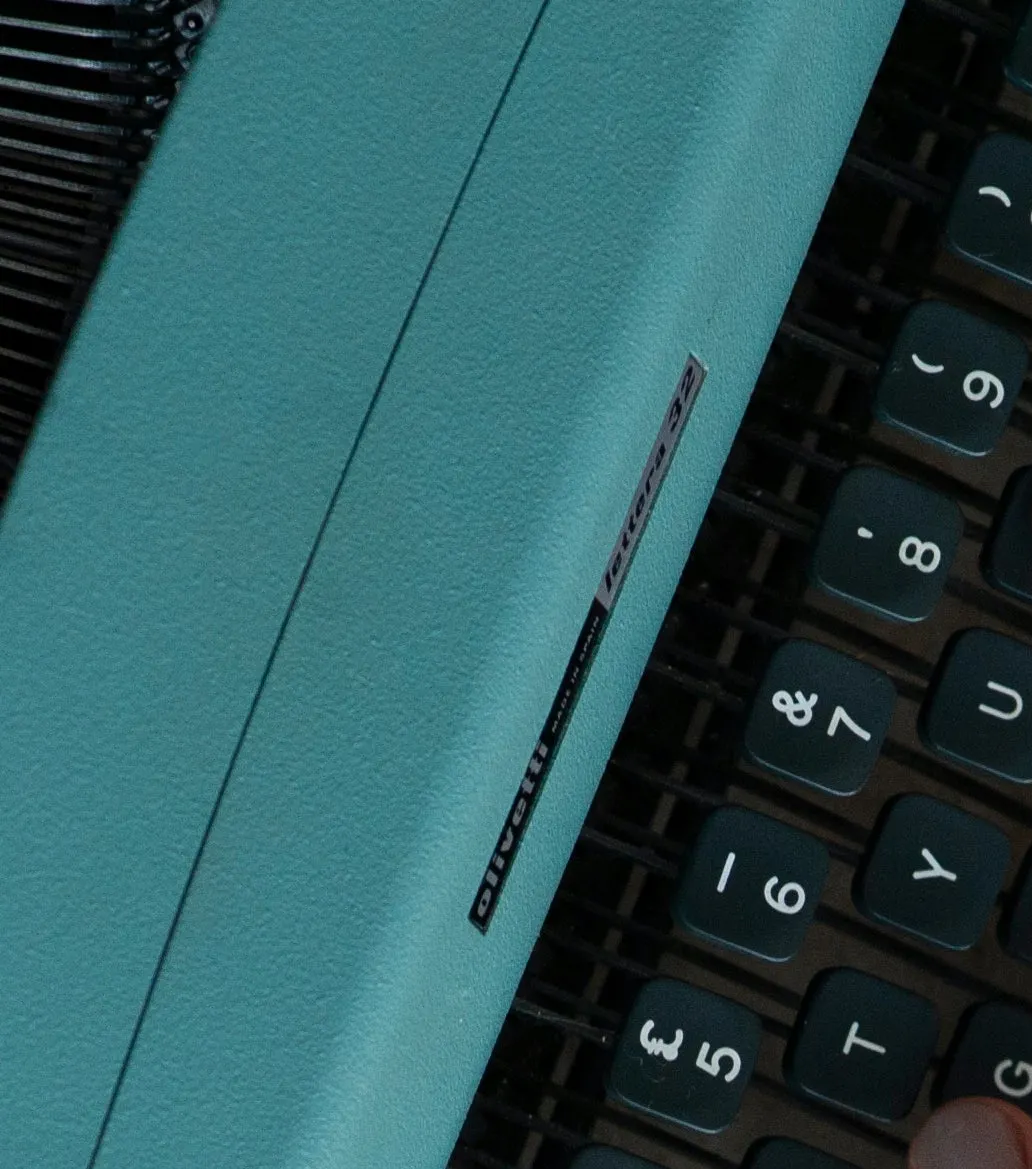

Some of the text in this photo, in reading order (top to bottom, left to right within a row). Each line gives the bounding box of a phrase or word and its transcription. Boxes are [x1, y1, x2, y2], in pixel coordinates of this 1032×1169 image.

[978, 186, 1012, 208] )
[911, 353, 945, 374] (
[962, 370, 1005, 409] 9
[604, 365, 696, 594] lettera 32
[898, 535, 942, 573] 8
[771, 690, 819, 727] &
[978, 681, 1024, 720] U
[826, 705, 872, 742] 7
[477, 741, 549, 918] olivetti
[912, 848, 957, 882] Y
[763, 875, 806, 915] 6
[639, 1019, 684, 1062] £
[842, 1021, 886, 1055] T
[695, 1041, 742, 1083] 5
